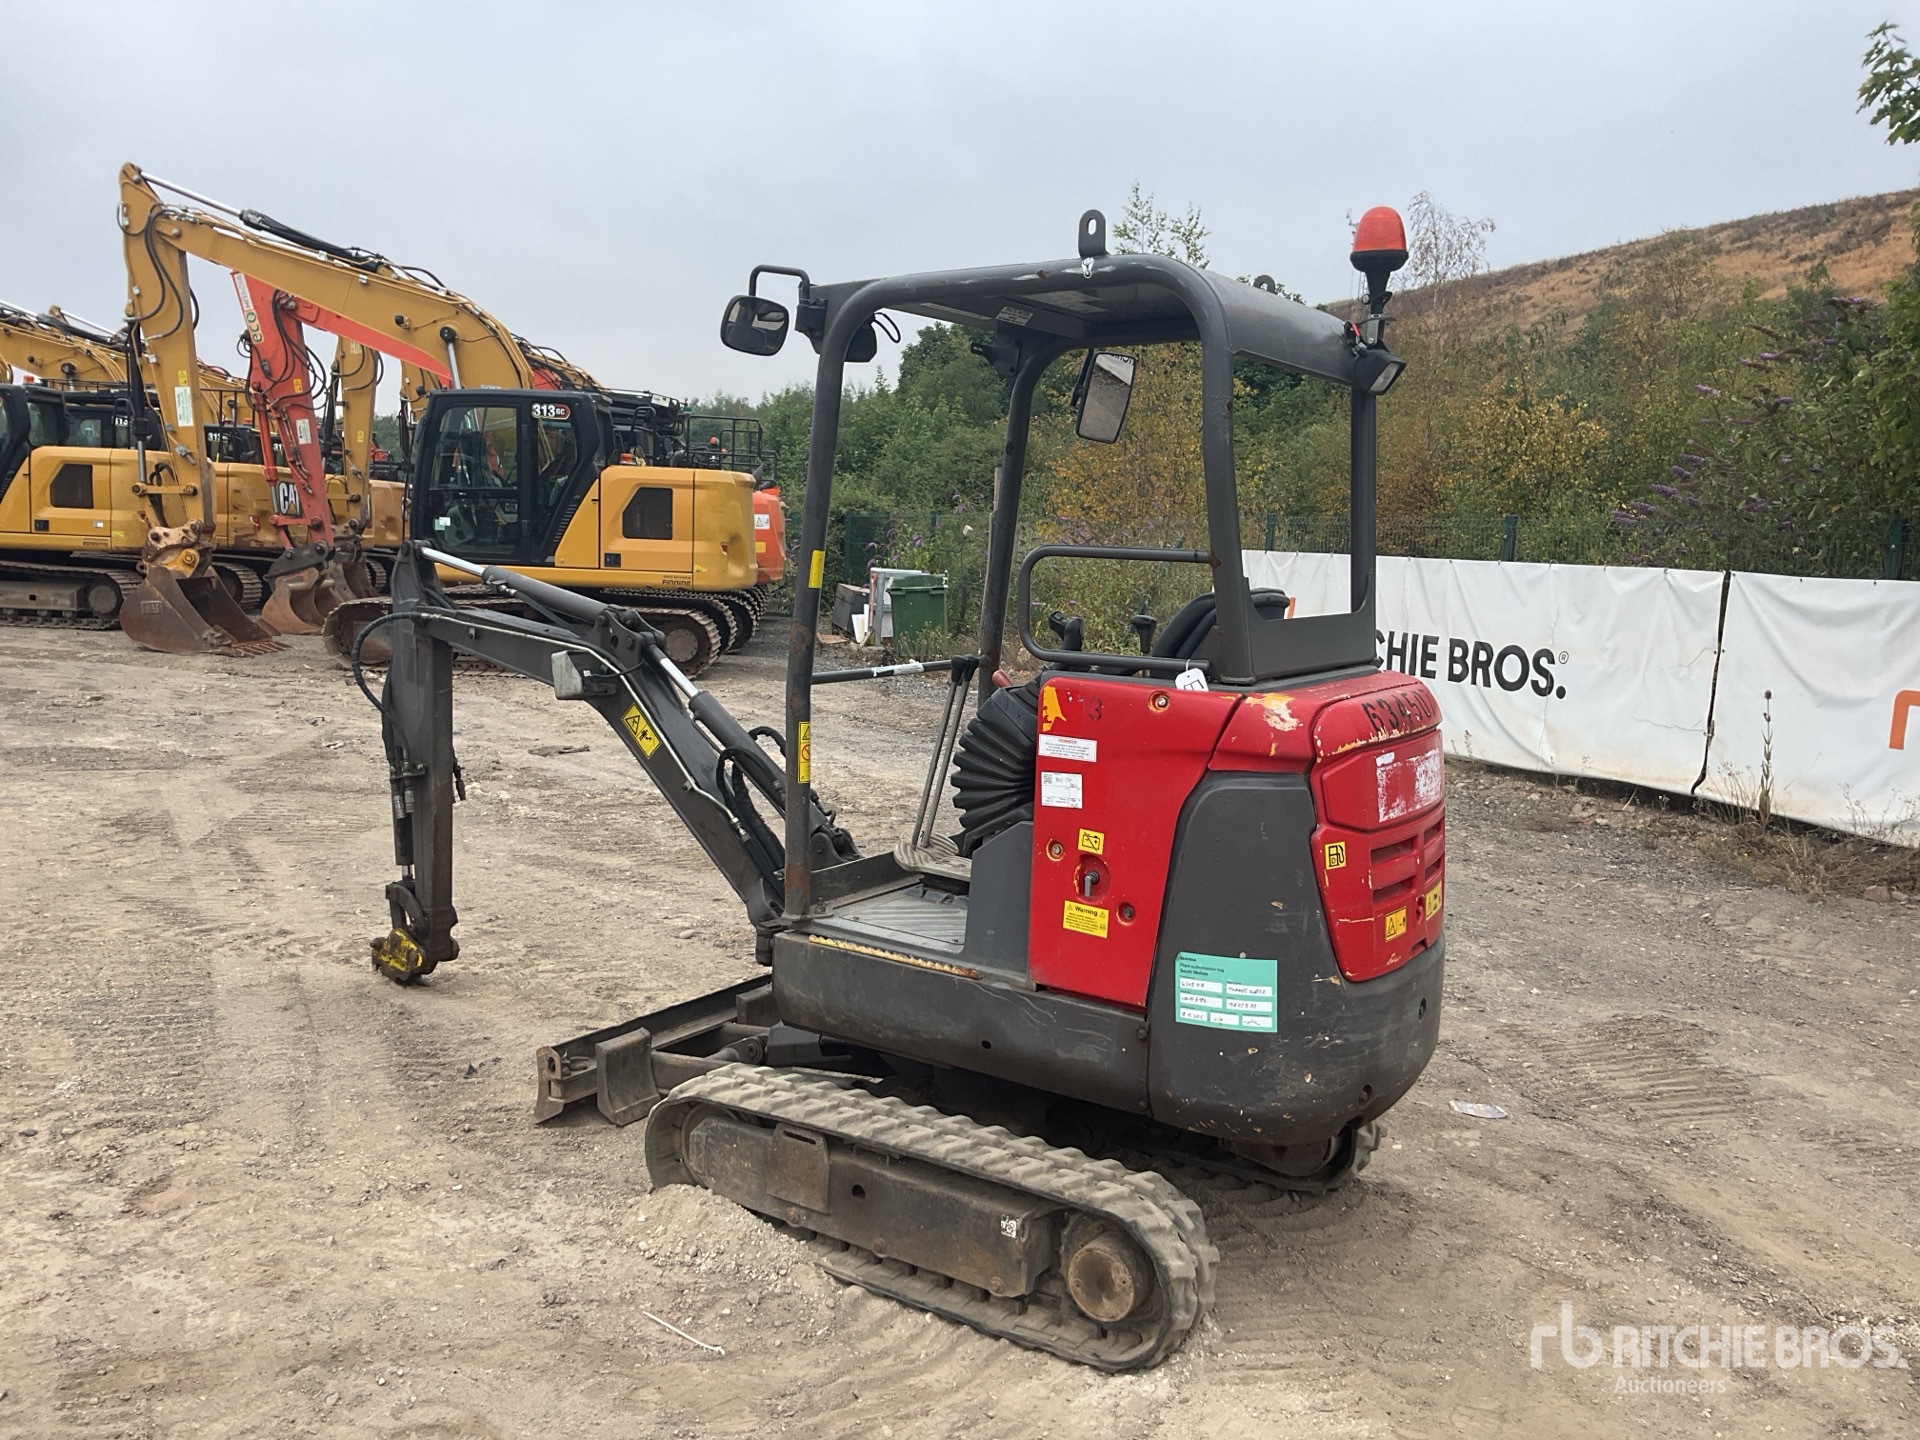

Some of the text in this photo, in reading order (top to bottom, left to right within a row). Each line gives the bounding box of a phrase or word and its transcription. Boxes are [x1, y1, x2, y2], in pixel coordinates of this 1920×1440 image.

[246, 312, 263, 342] eco
[532, 403, 556, 417] 313
[1447, 637, 1566, 700] BROS.
[1074, 905, 1098, 917] Warning
